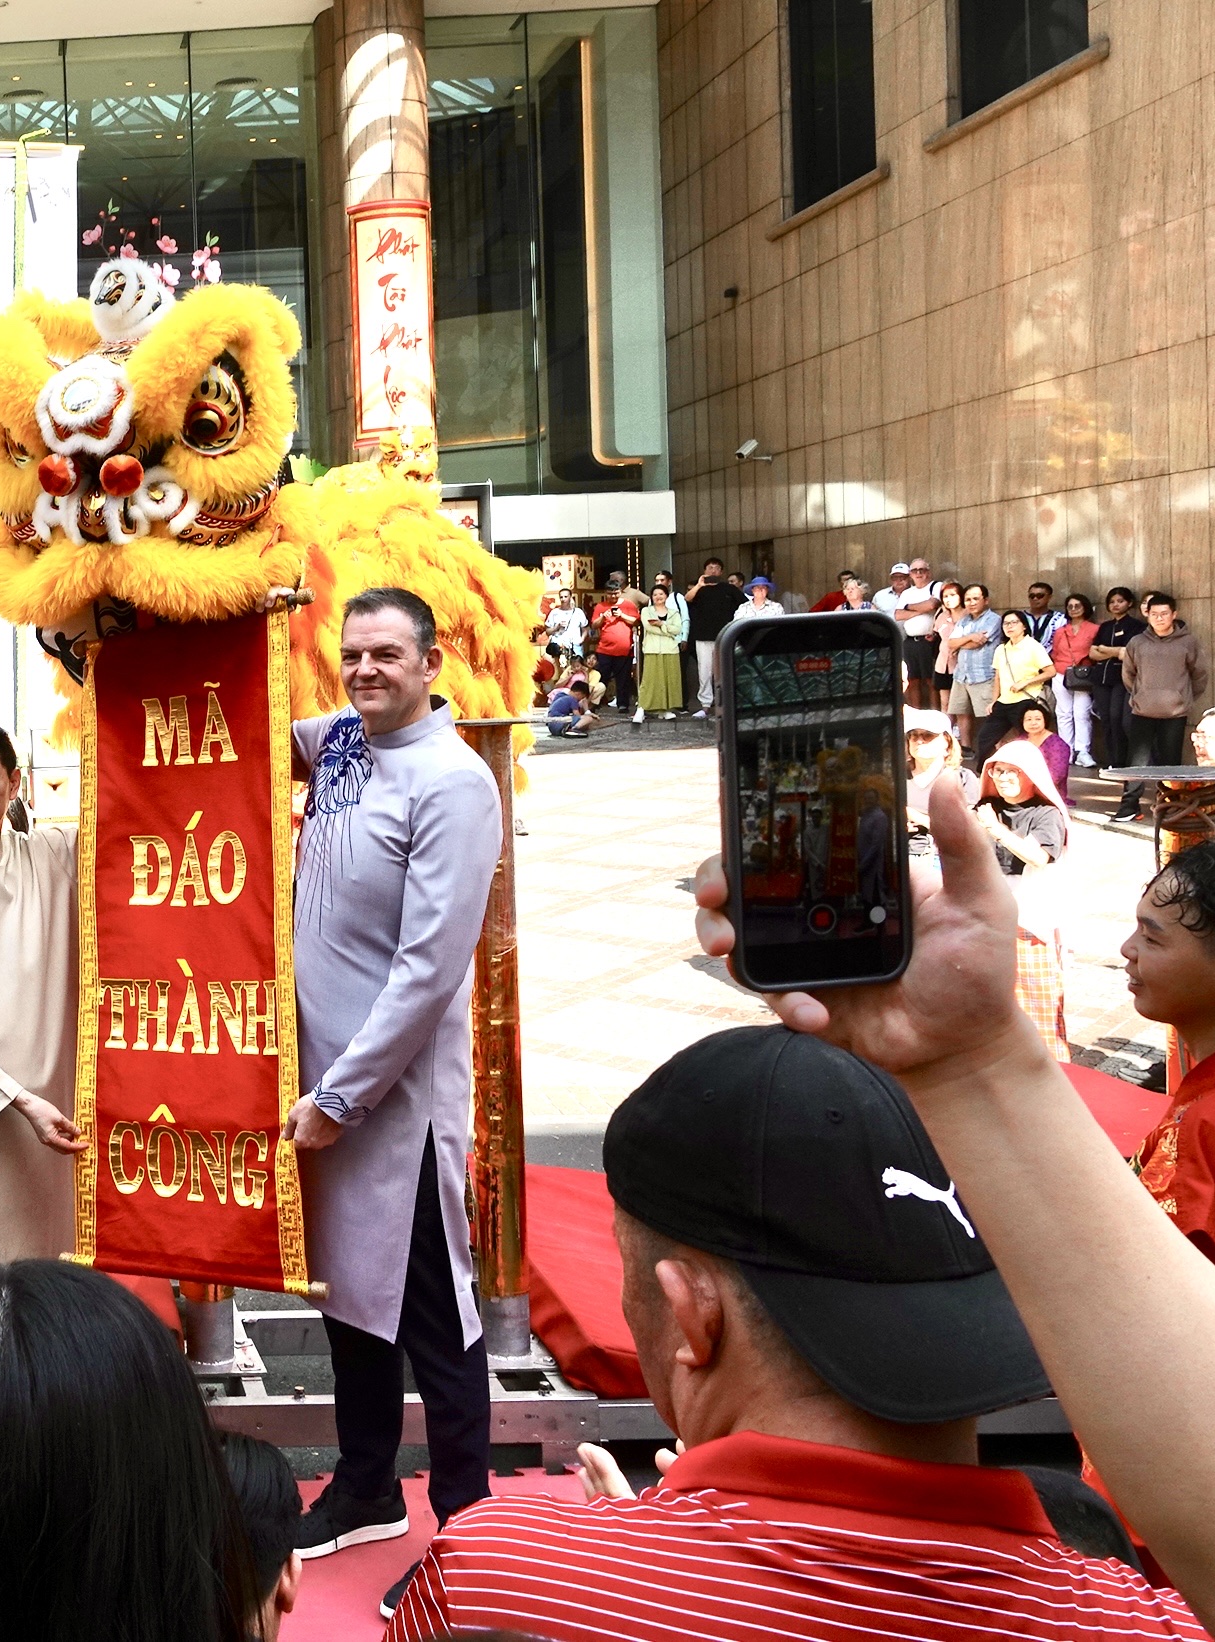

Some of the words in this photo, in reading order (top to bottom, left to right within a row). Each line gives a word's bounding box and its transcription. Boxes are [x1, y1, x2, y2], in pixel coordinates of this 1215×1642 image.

[142, 681, 238, 766] MÃ
[129, 811, 247, 907] ĐÁO
[98, 958, 279, 1056] THÀNH
[109, 1103, 268, 1209] CÔNG
